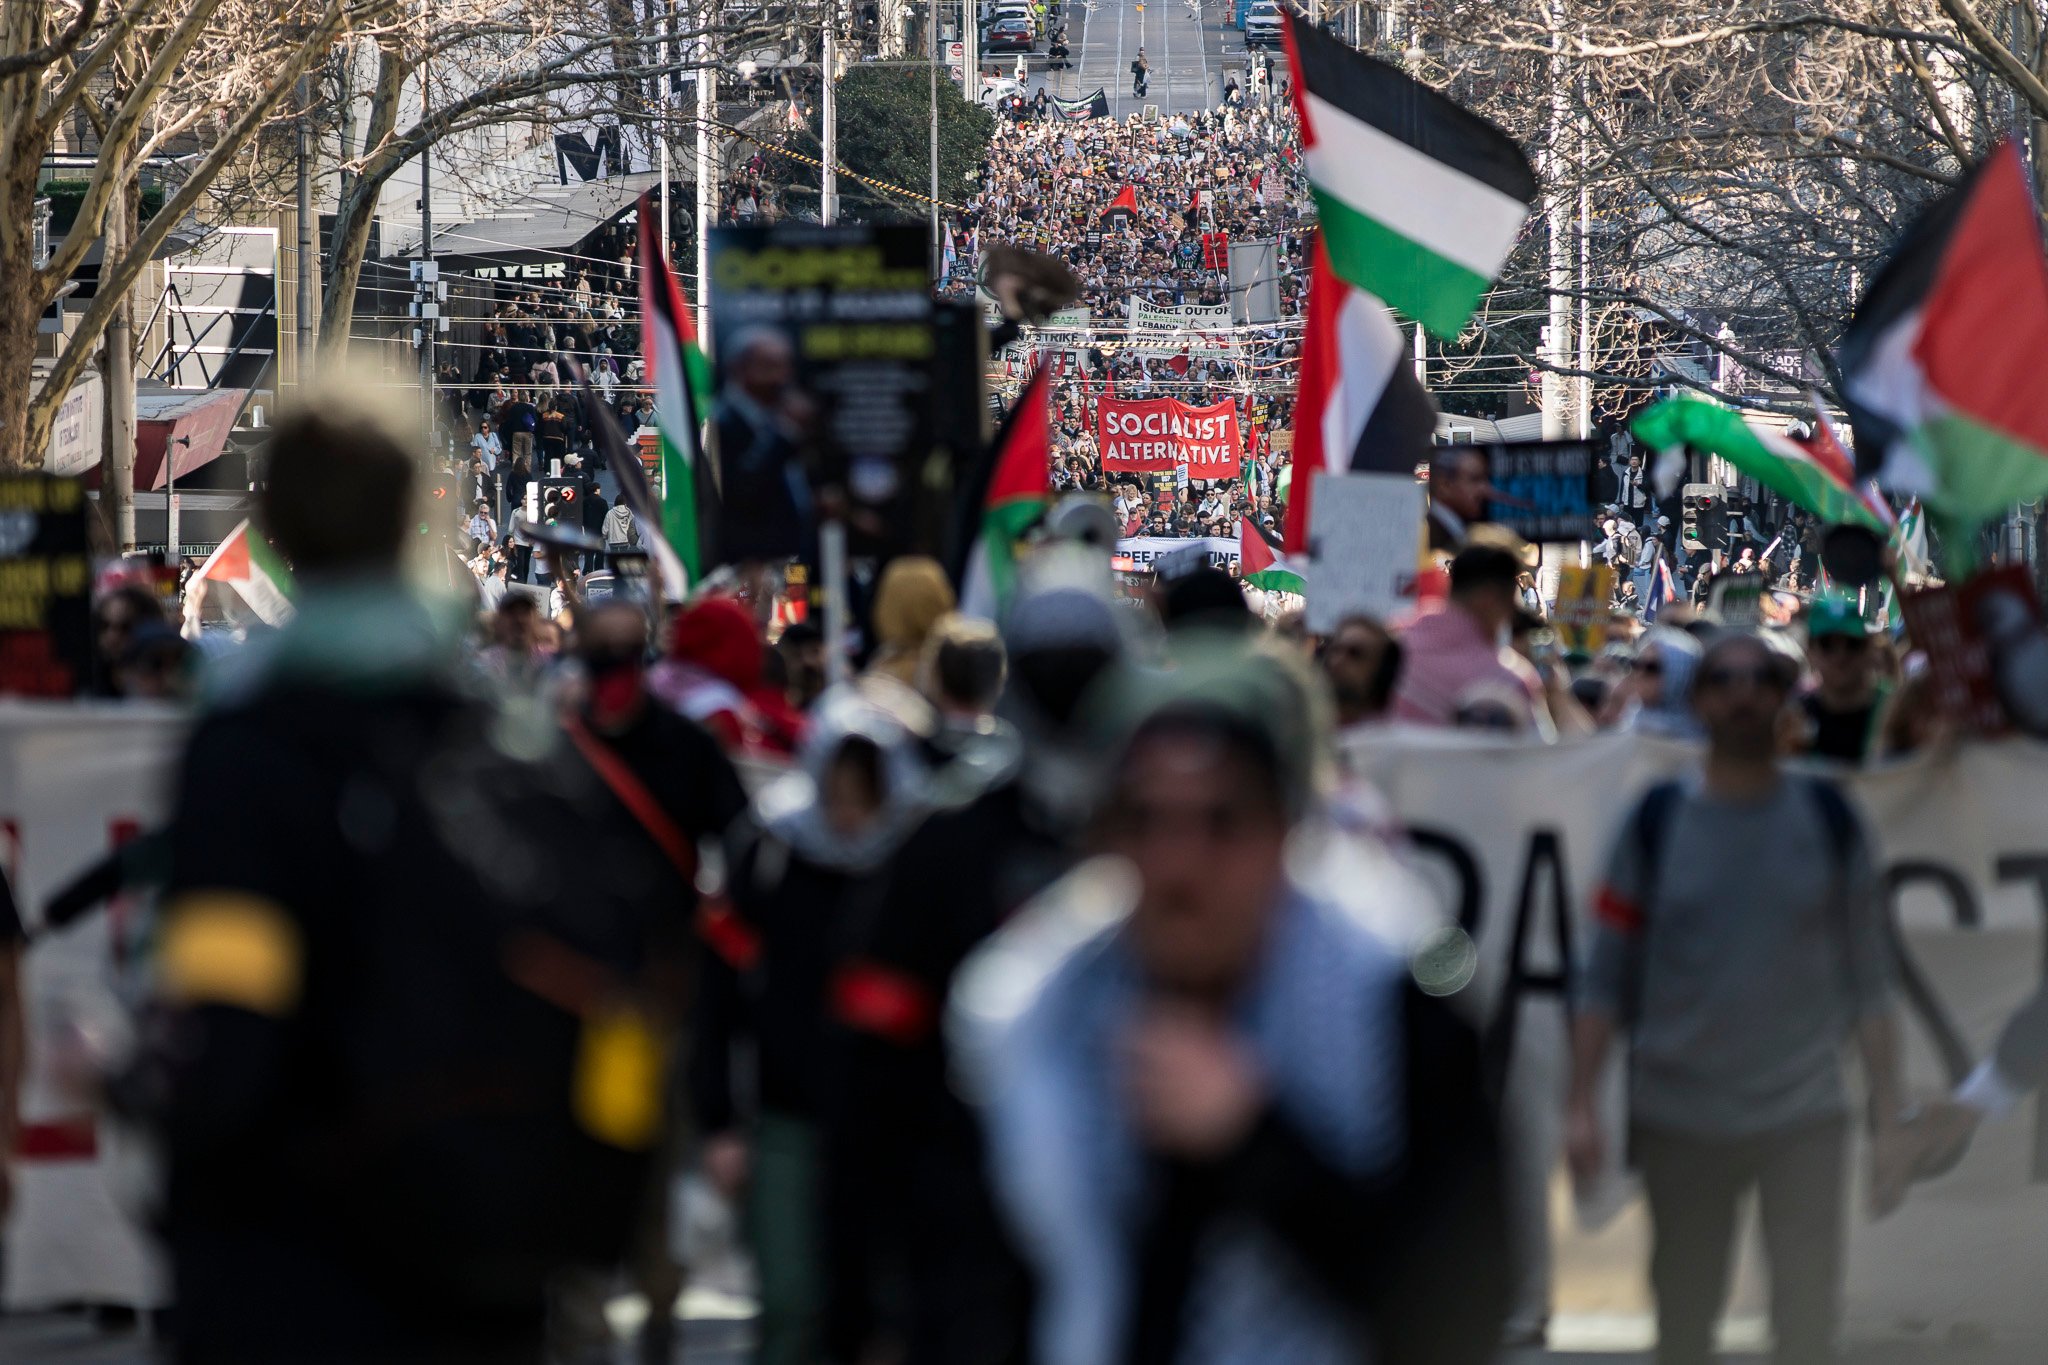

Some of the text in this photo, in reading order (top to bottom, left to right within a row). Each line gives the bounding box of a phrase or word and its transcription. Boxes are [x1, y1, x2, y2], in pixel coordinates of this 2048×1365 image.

[474, 262, 566, 278] MYER
[1138, 302, 1181, 315] ISRAEL
[1185, 306, 1211, 315] OUT
[1052, 316, 1080, 325] GAZA
[1106, 411, 1230, 441] SOCIALIST
[1106, 440, 1231, 464] ALTERNATIVE
